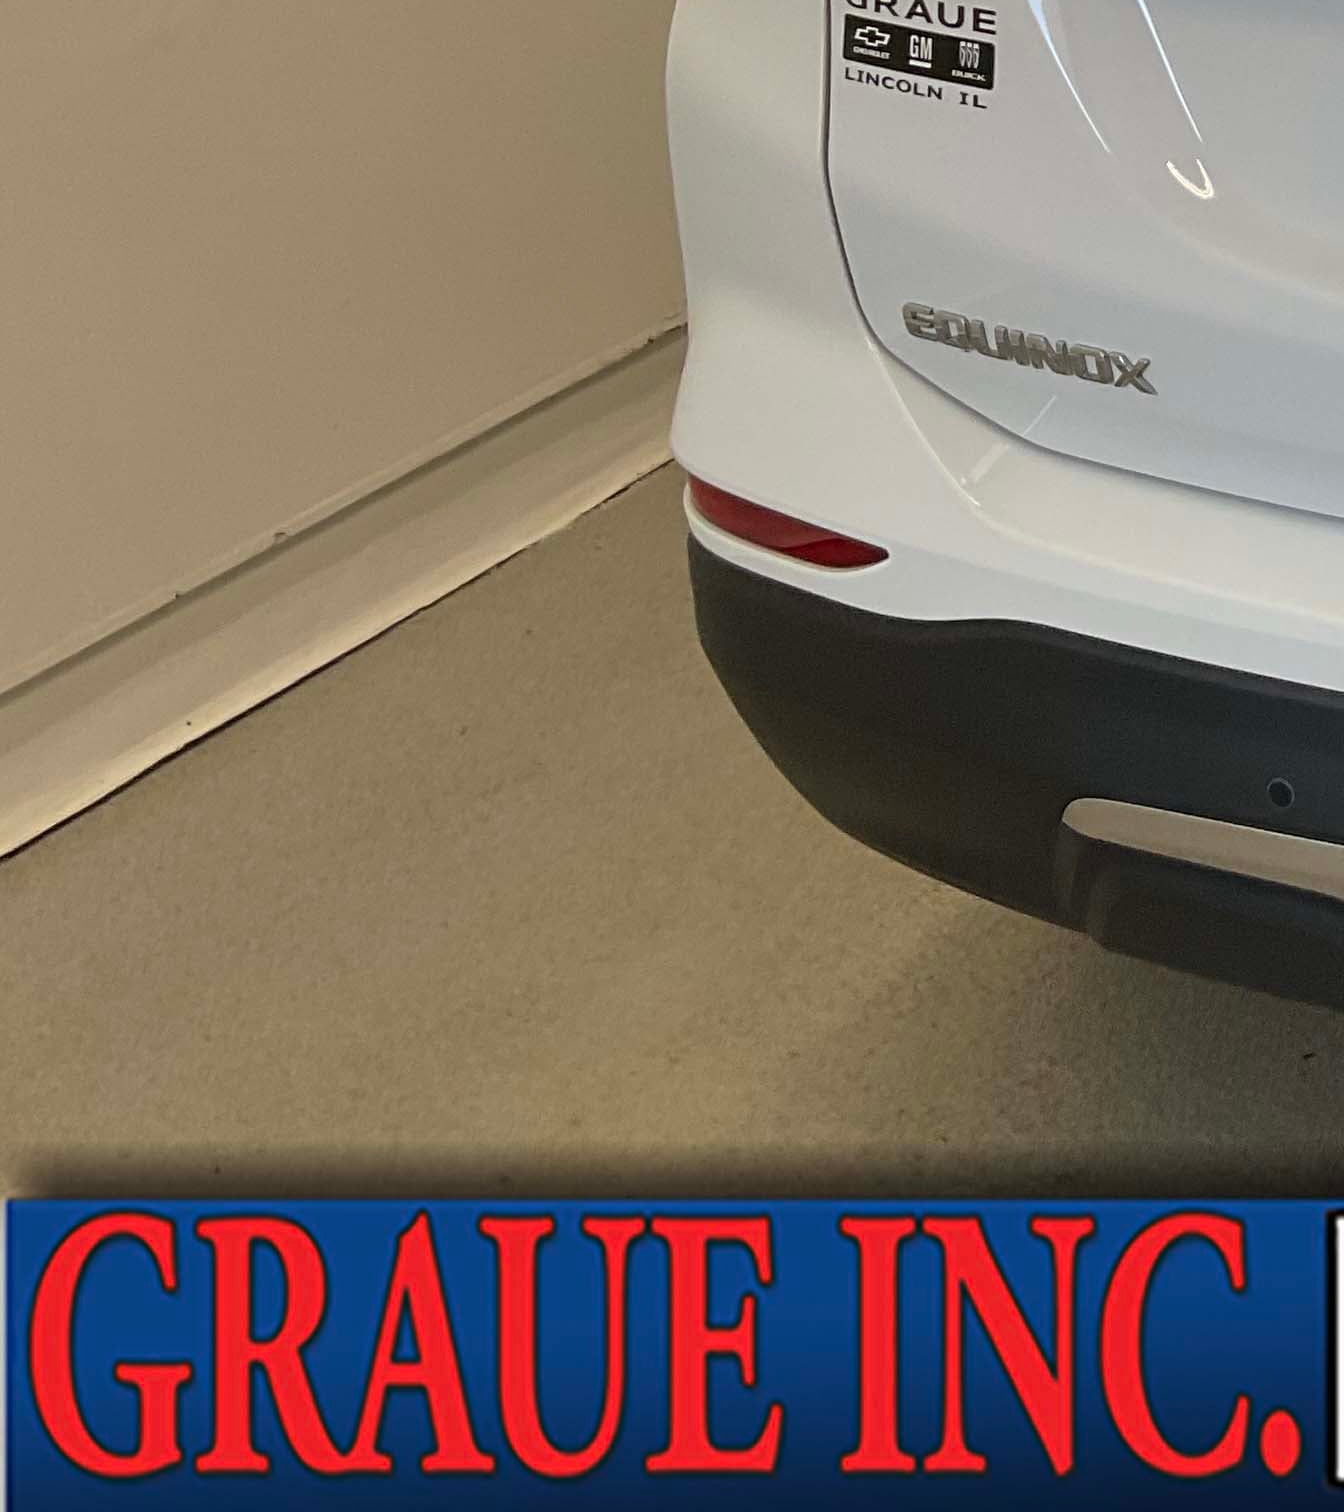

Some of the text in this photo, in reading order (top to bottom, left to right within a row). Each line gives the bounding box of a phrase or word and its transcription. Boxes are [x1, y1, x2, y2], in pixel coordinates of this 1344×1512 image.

[909, 34, 933, 60] GM
[845, 67, 987, 109] LINCOLN IL
[901, 301, 1160, 396] EQUINOX
